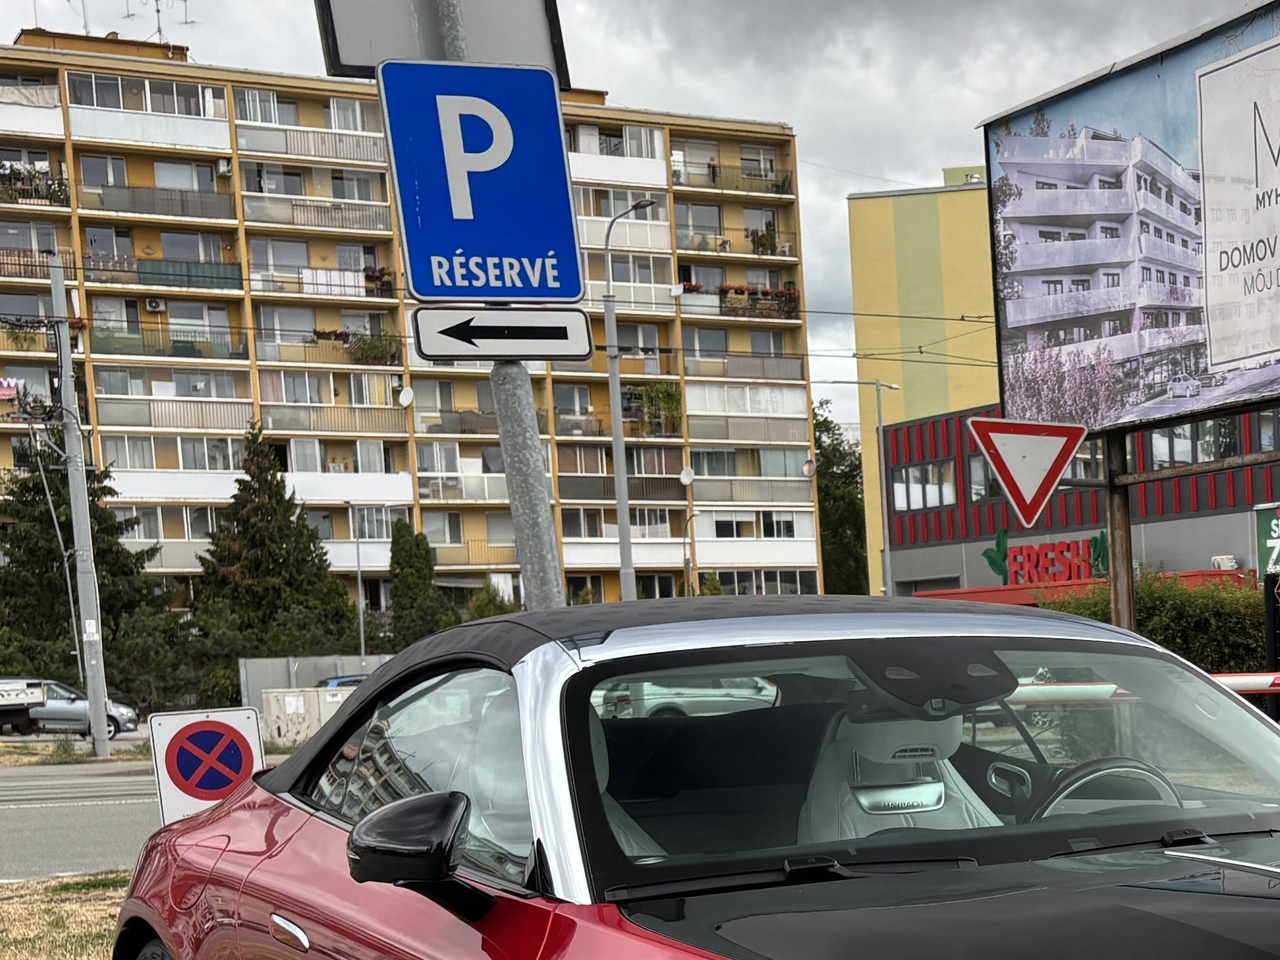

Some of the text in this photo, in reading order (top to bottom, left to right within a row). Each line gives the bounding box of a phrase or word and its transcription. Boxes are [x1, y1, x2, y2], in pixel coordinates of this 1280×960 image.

[435, 95, 514, 220] P
[430, 248, 561, 288] RÉSERVÉ
[1219, 235, 1278, 272] DOMOV
[1243, 268, 1273, 296] MÔJ
[1008, 539, 1092, 585] FRESH
